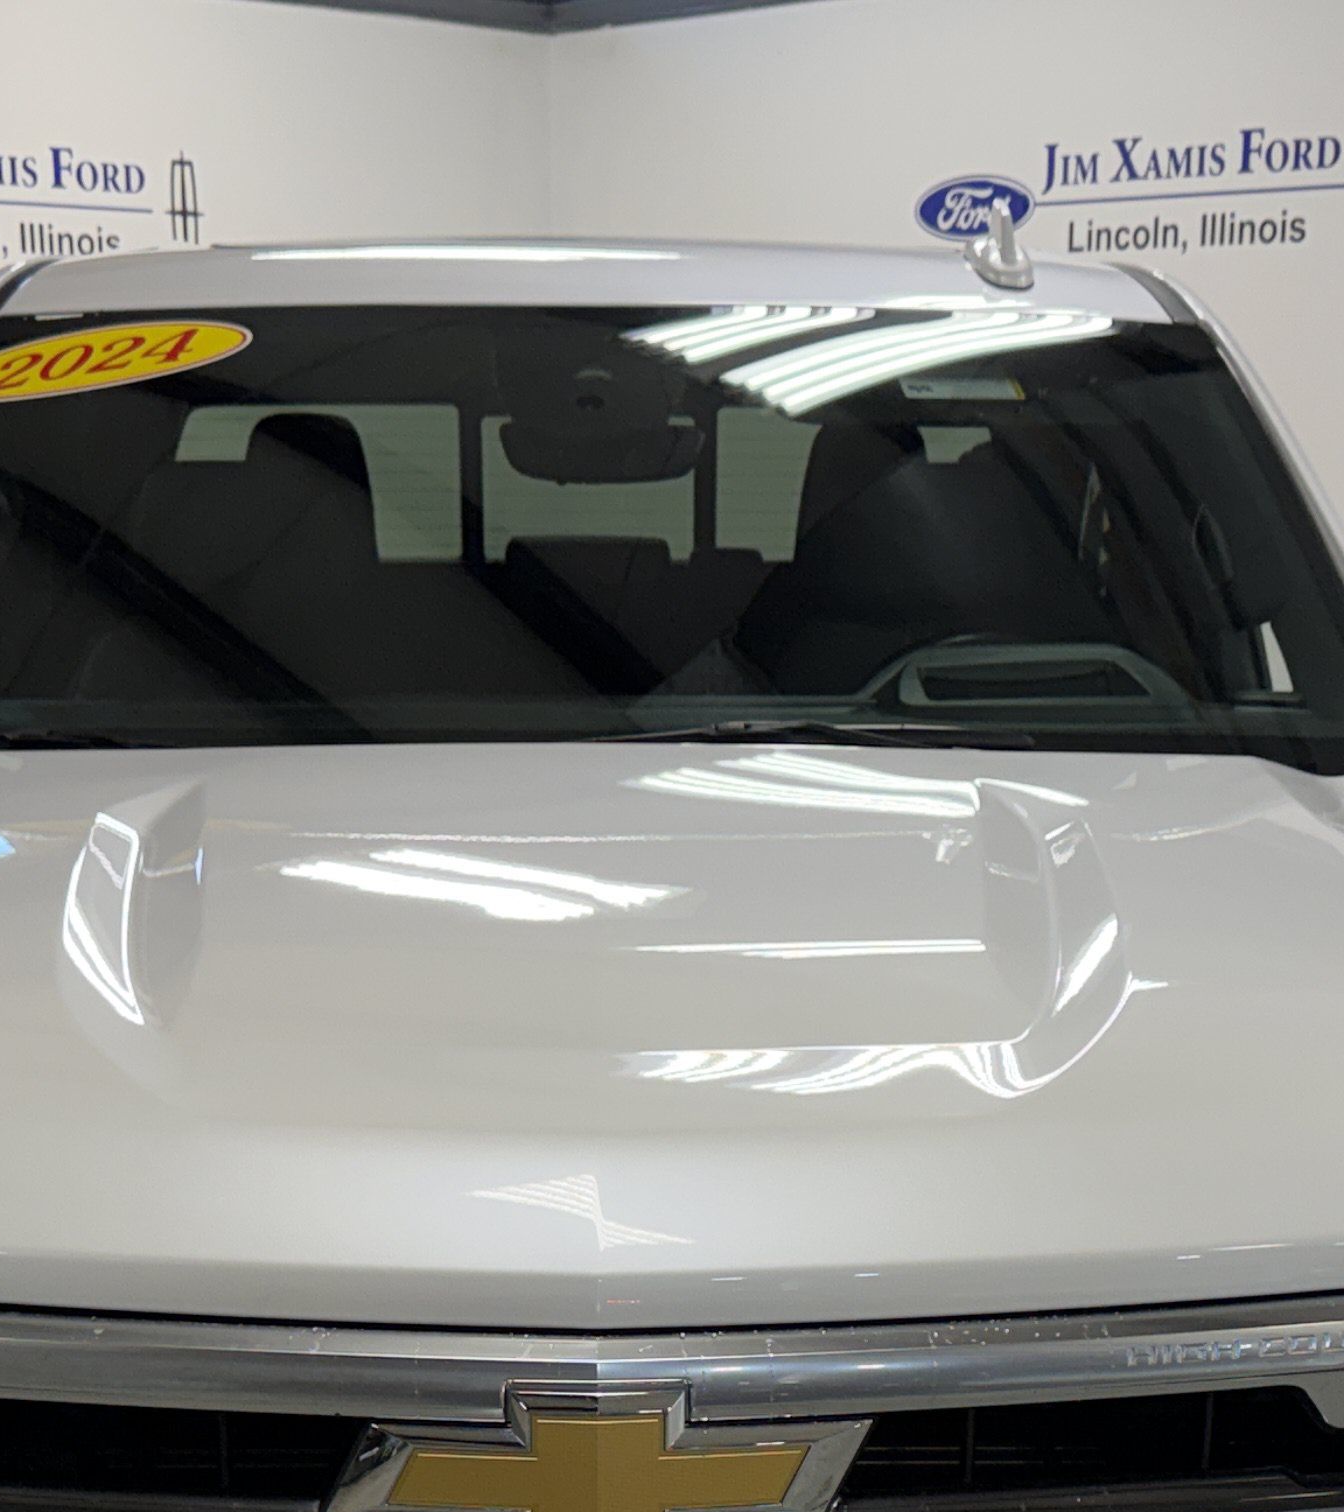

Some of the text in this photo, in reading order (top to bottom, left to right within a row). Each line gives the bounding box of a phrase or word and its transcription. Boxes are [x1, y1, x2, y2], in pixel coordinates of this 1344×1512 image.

[48, 146, 146, 195] FORD
[1042, 127, 1343, 195] JIM XAMIS FORD
[19, 222, 121, 256] Illinois
[1067, 210, 1307, 253] Lincoln, Illinois
[1126, 1338, 1242, 1367] HIGH
